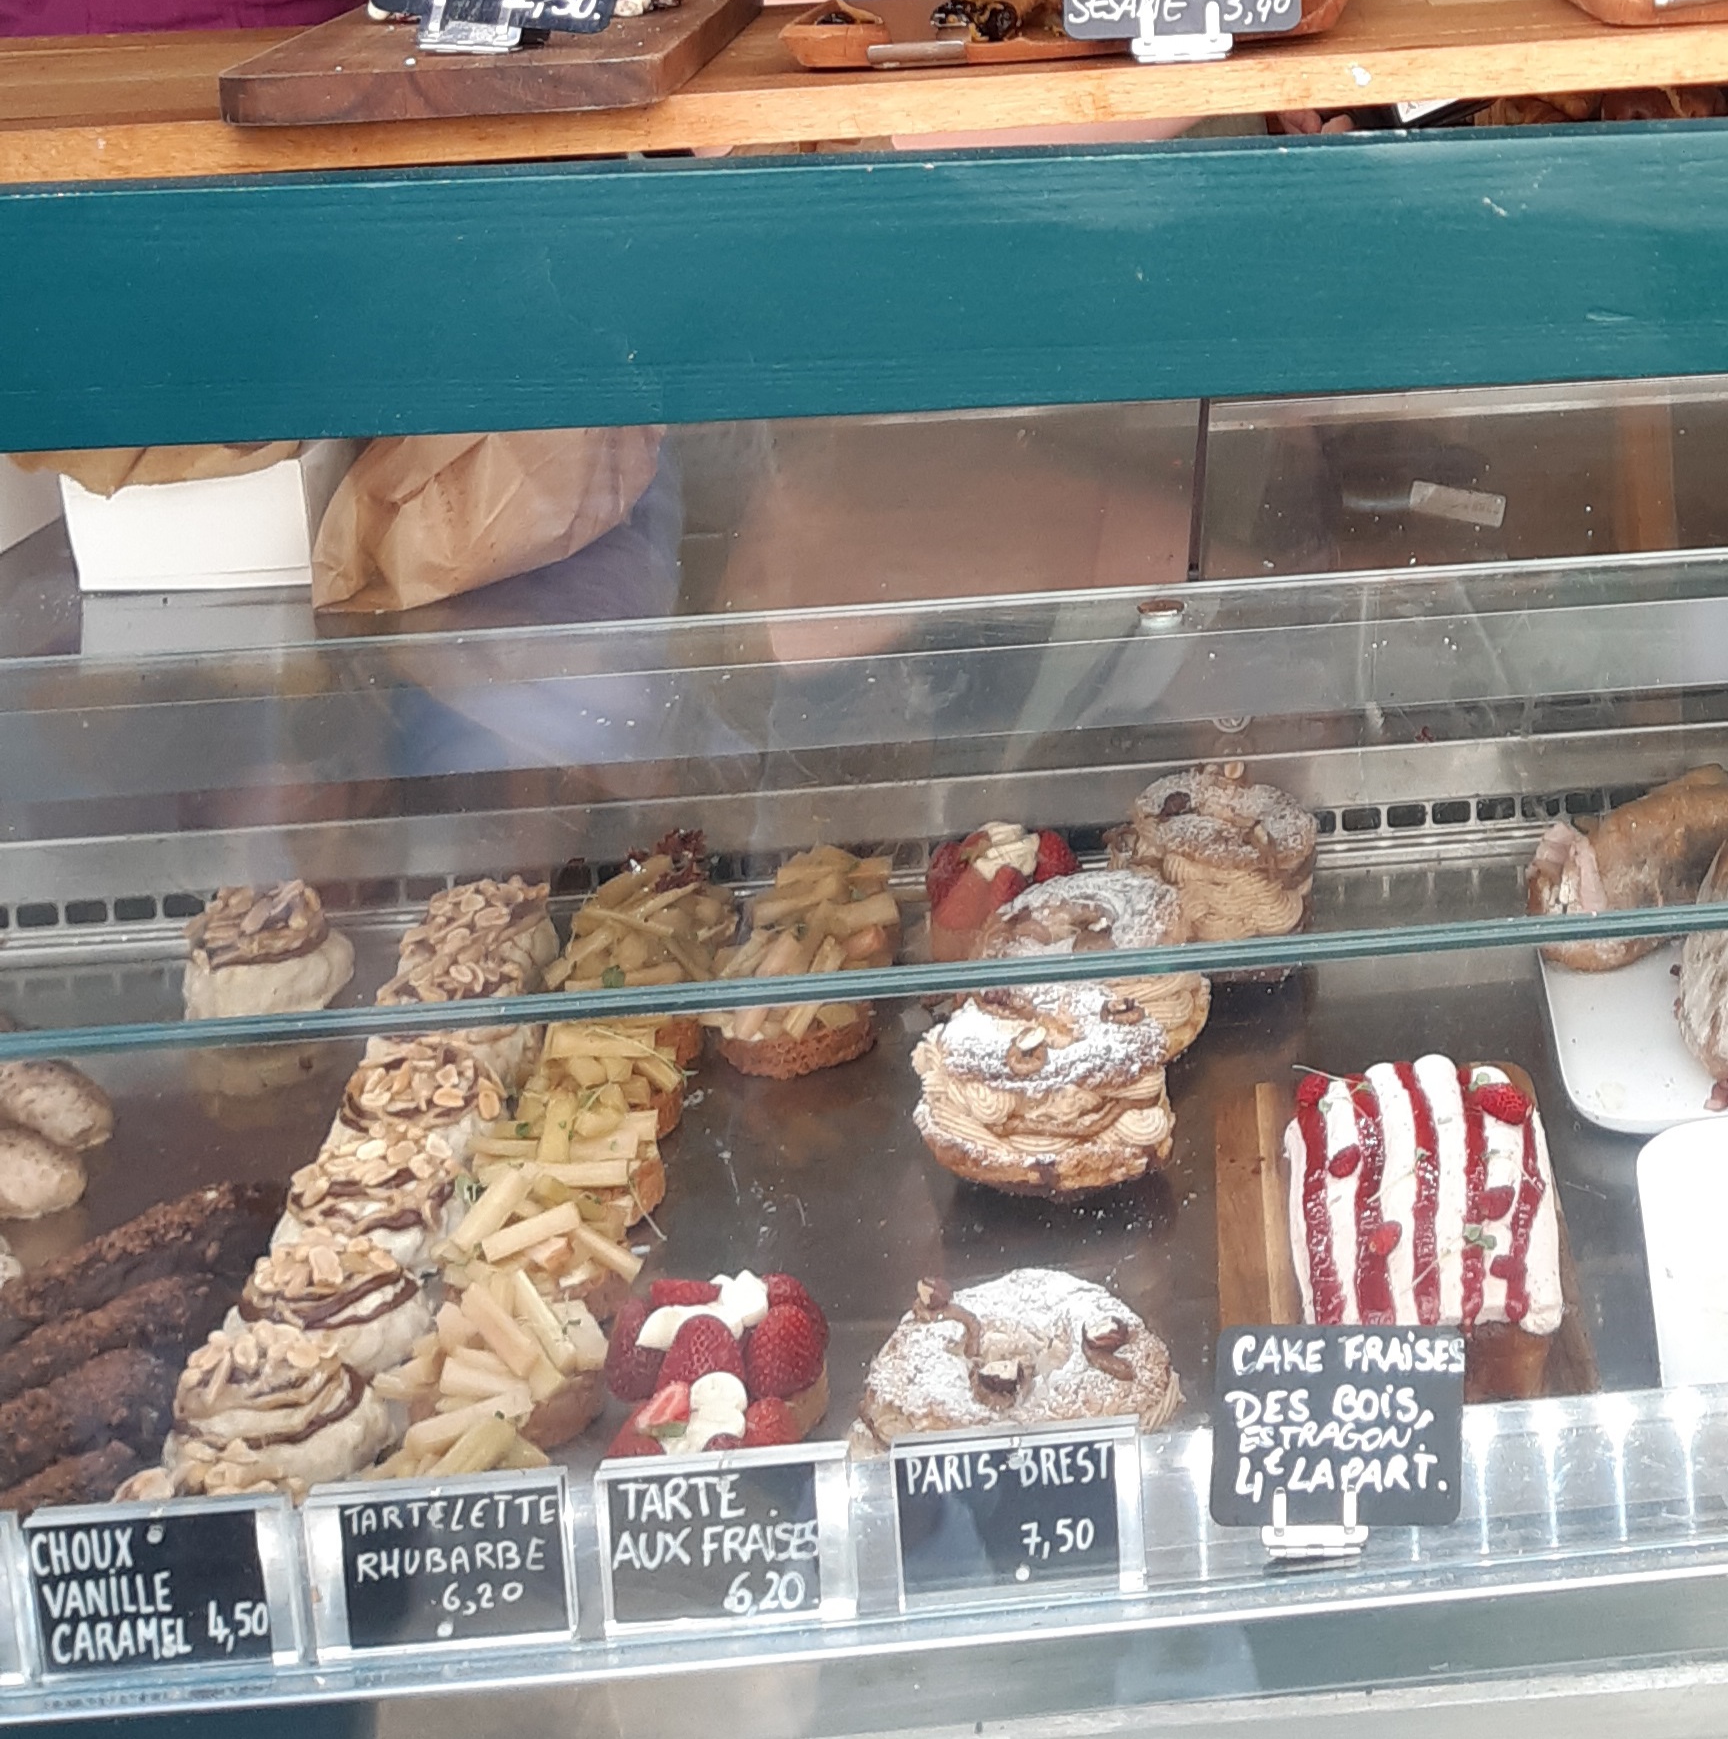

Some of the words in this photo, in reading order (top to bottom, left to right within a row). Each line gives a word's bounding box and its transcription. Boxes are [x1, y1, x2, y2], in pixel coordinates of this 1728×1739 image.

[1232, 1335, 1326, 1377] CAKE
[1337, 1330, 1465, 1373] FRAISES
[1224, 1388, 1310, 1429] DES
[905, 1441, 1113, 1496] PARIS-BREST
[343, 1494, 558, 1537] TARTELETTE
[617, 1473, 746, 1523] TARTE
[31, 1526, 134, 1577] CHOUX
[356, 1537, 546, 1583] RHUBARBE
[612, 1526, 693, 1571] AUX
[702, 1508, 818, 1567] FRAISES
[1020, 1517, 1095, 1560] 7,50
[42, 1567, 173, 1619] VANILLE
[441, 1580, 524, 1616] 6,20
[51, 1617, 192, 1665] CARAMEL
[207, 1600, 269, 1653] 4,50
